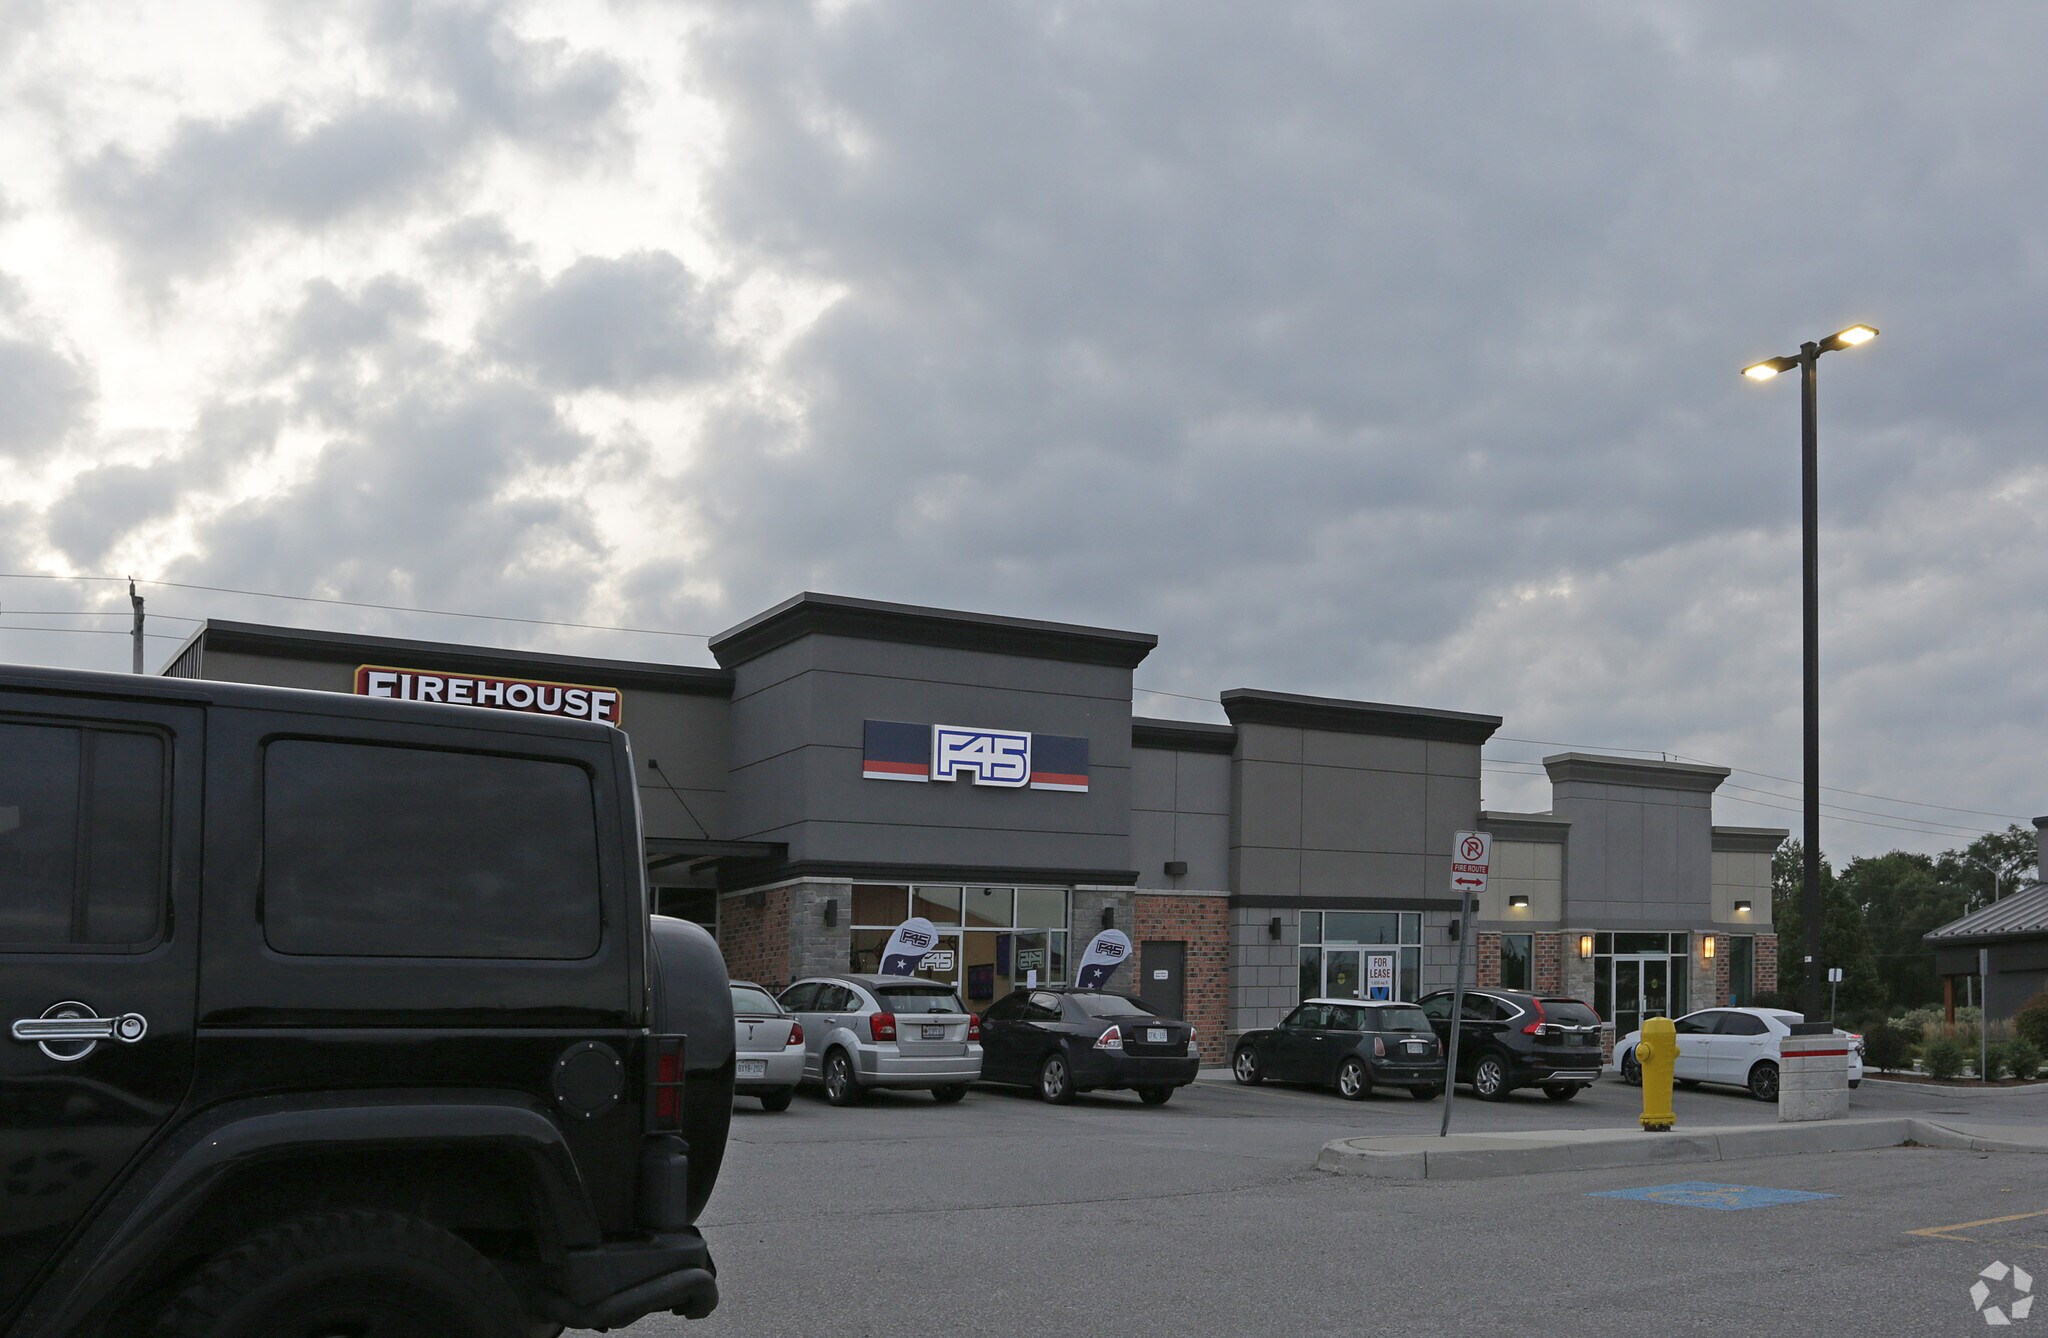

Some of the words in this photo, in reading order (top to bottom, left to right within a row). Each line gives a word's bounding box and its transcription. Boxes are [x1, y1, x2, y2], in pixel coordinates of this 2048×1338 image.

[368, 671, 616, 728] FIREHOUSE
[937, 729, 1028, 783] F45
[1455, 864, 1467, 872] FIRE
[1467, 865, 1486, 873] ROUTE
[900, 928, 931, 948] F45
[1096, 940, 1125, 957] F45
[920, 950, 954, 971] F45
[1373, 957, 1388, 967] FOR
[1370, 969, 1391, 979] LEASE
